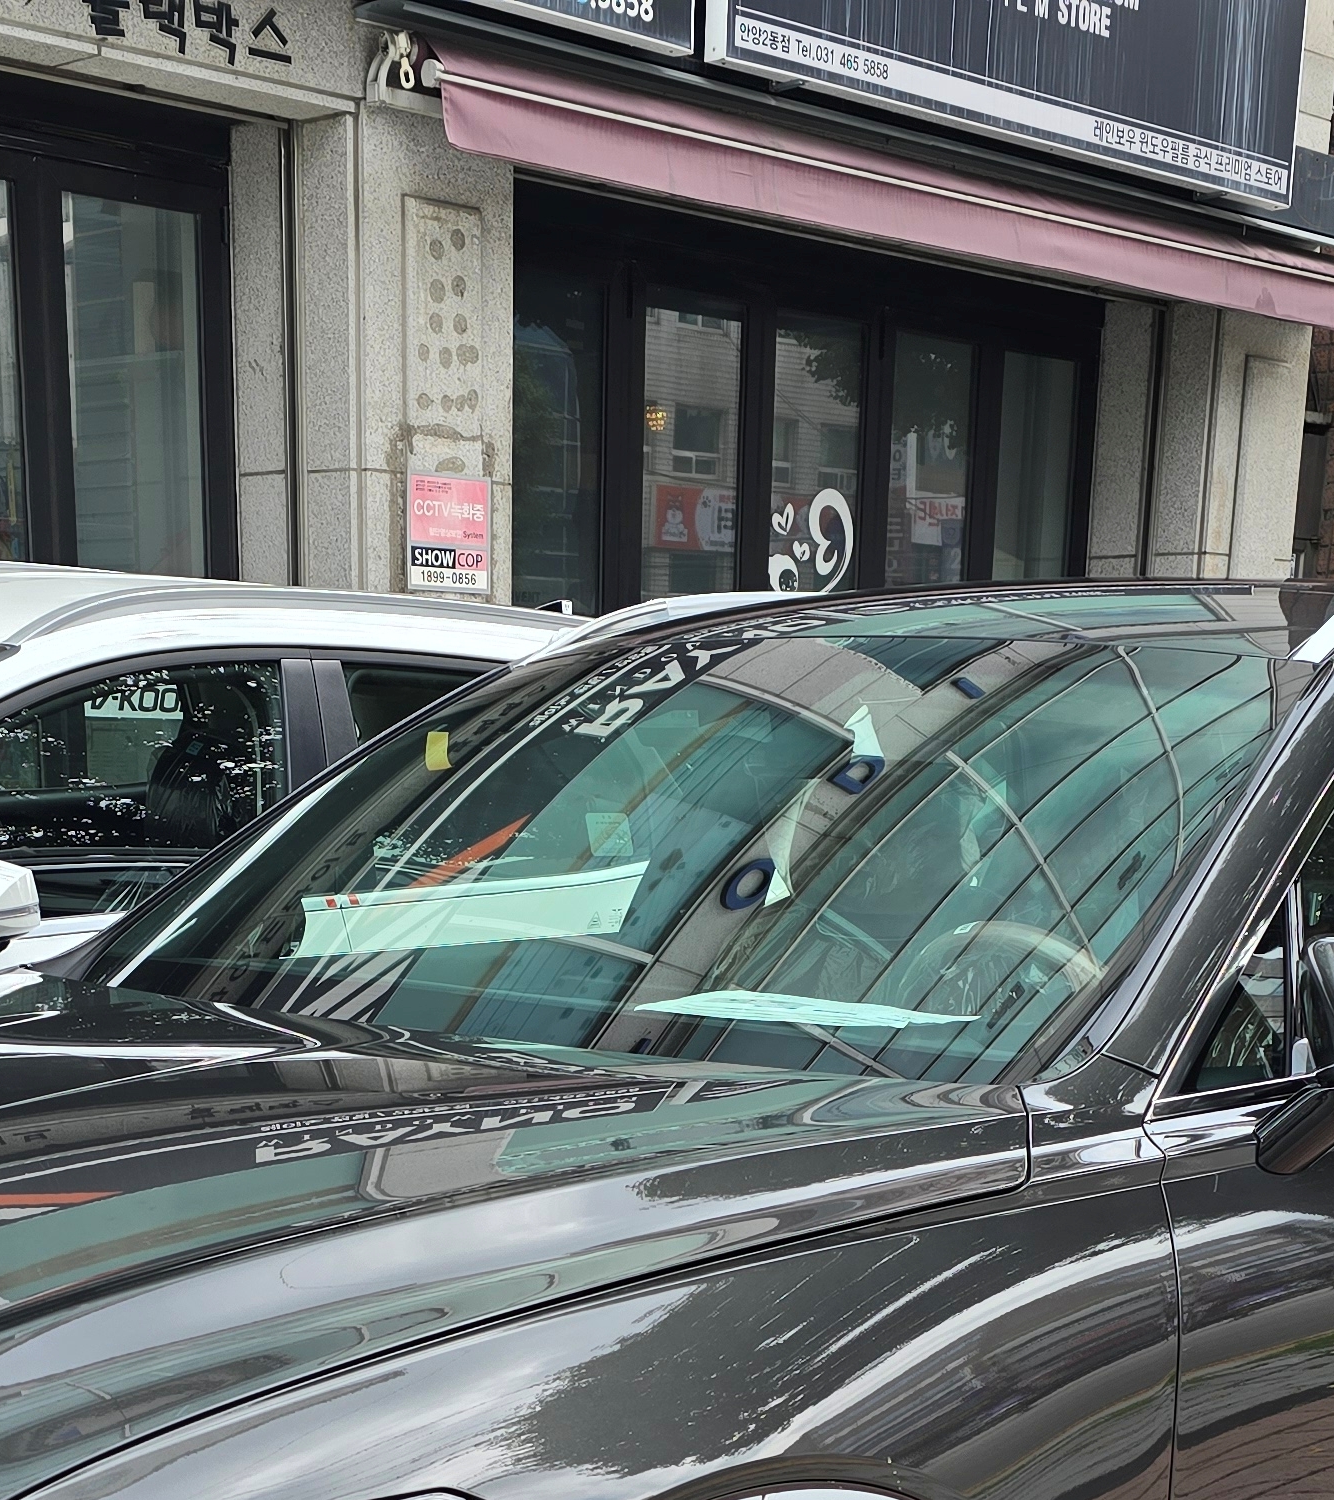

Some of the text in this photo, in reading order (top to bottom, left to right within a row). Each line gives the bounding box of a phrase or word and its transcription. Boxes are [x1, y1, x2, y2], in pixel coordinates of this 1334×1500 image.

[1058, 0, 1111, 38] STORE
[739, 24, 791, 54] 안양2동점
[839, 53, 860, 72] 465
[862, 58, 889, 80] 5858
[1093, 120, 1283, 191] 레인보우 윈도우필름 공식 프리미엄 스토어
[462, 530, 484, 540] System
[414, 548, 483, 569] SHOW COP
[420, 569, 477, 586] 1899-0856
[90, 687, 182, 713] V-KOO
